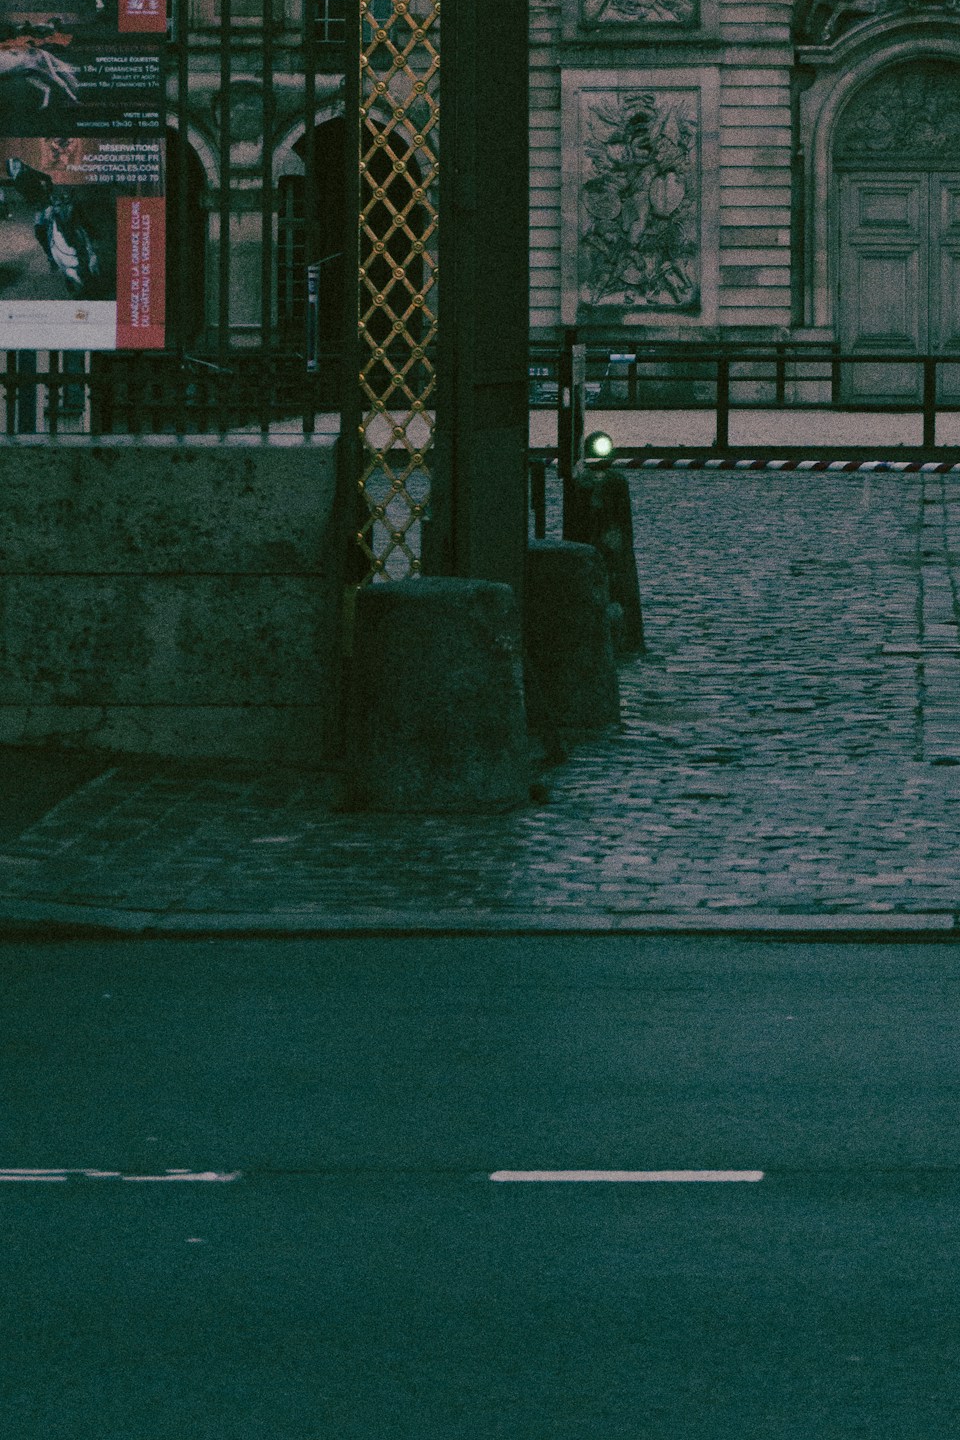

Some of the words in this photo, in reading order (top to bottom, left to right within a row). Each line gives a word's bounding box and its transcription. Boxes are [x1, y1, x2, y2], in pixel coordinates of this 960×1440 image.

[99, 143, 159, 152] RÉSERVATIONS
[141, 213, 150, 262] VERSAILLES
[141, 263, 150, 275] DE
